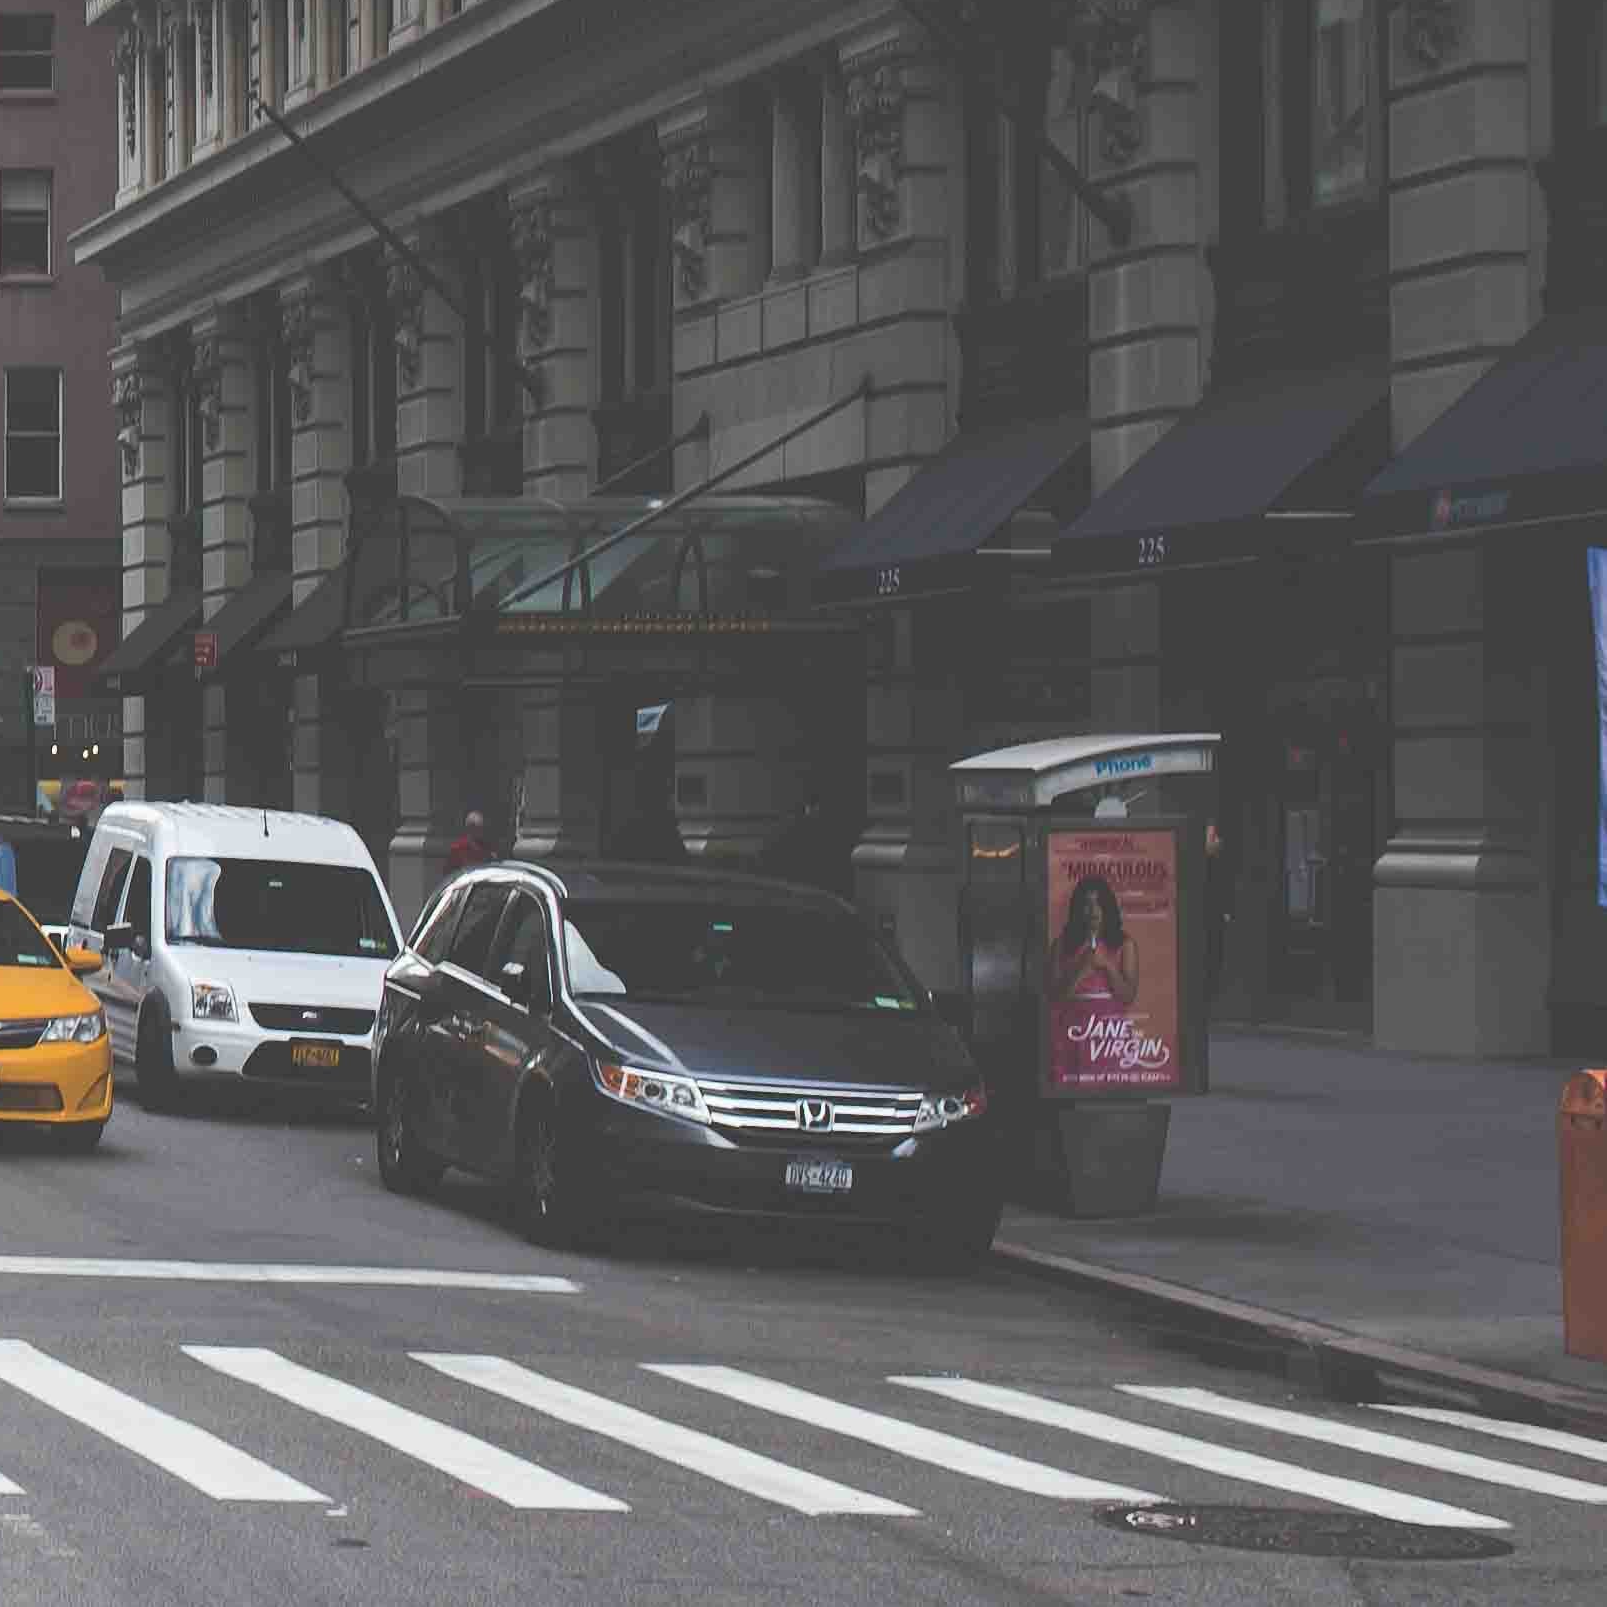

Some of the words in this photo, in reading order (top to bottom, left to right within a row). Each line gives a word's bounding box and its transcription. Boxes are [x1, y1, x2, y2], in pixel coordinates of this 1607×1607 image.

[1137, 538, 1164, 563] 225
[877, 569, 900, 594] 225
[1066, 1014, 1133, 1042] JANE
[1088, 1037, 1170, 1069] VIRGIN
